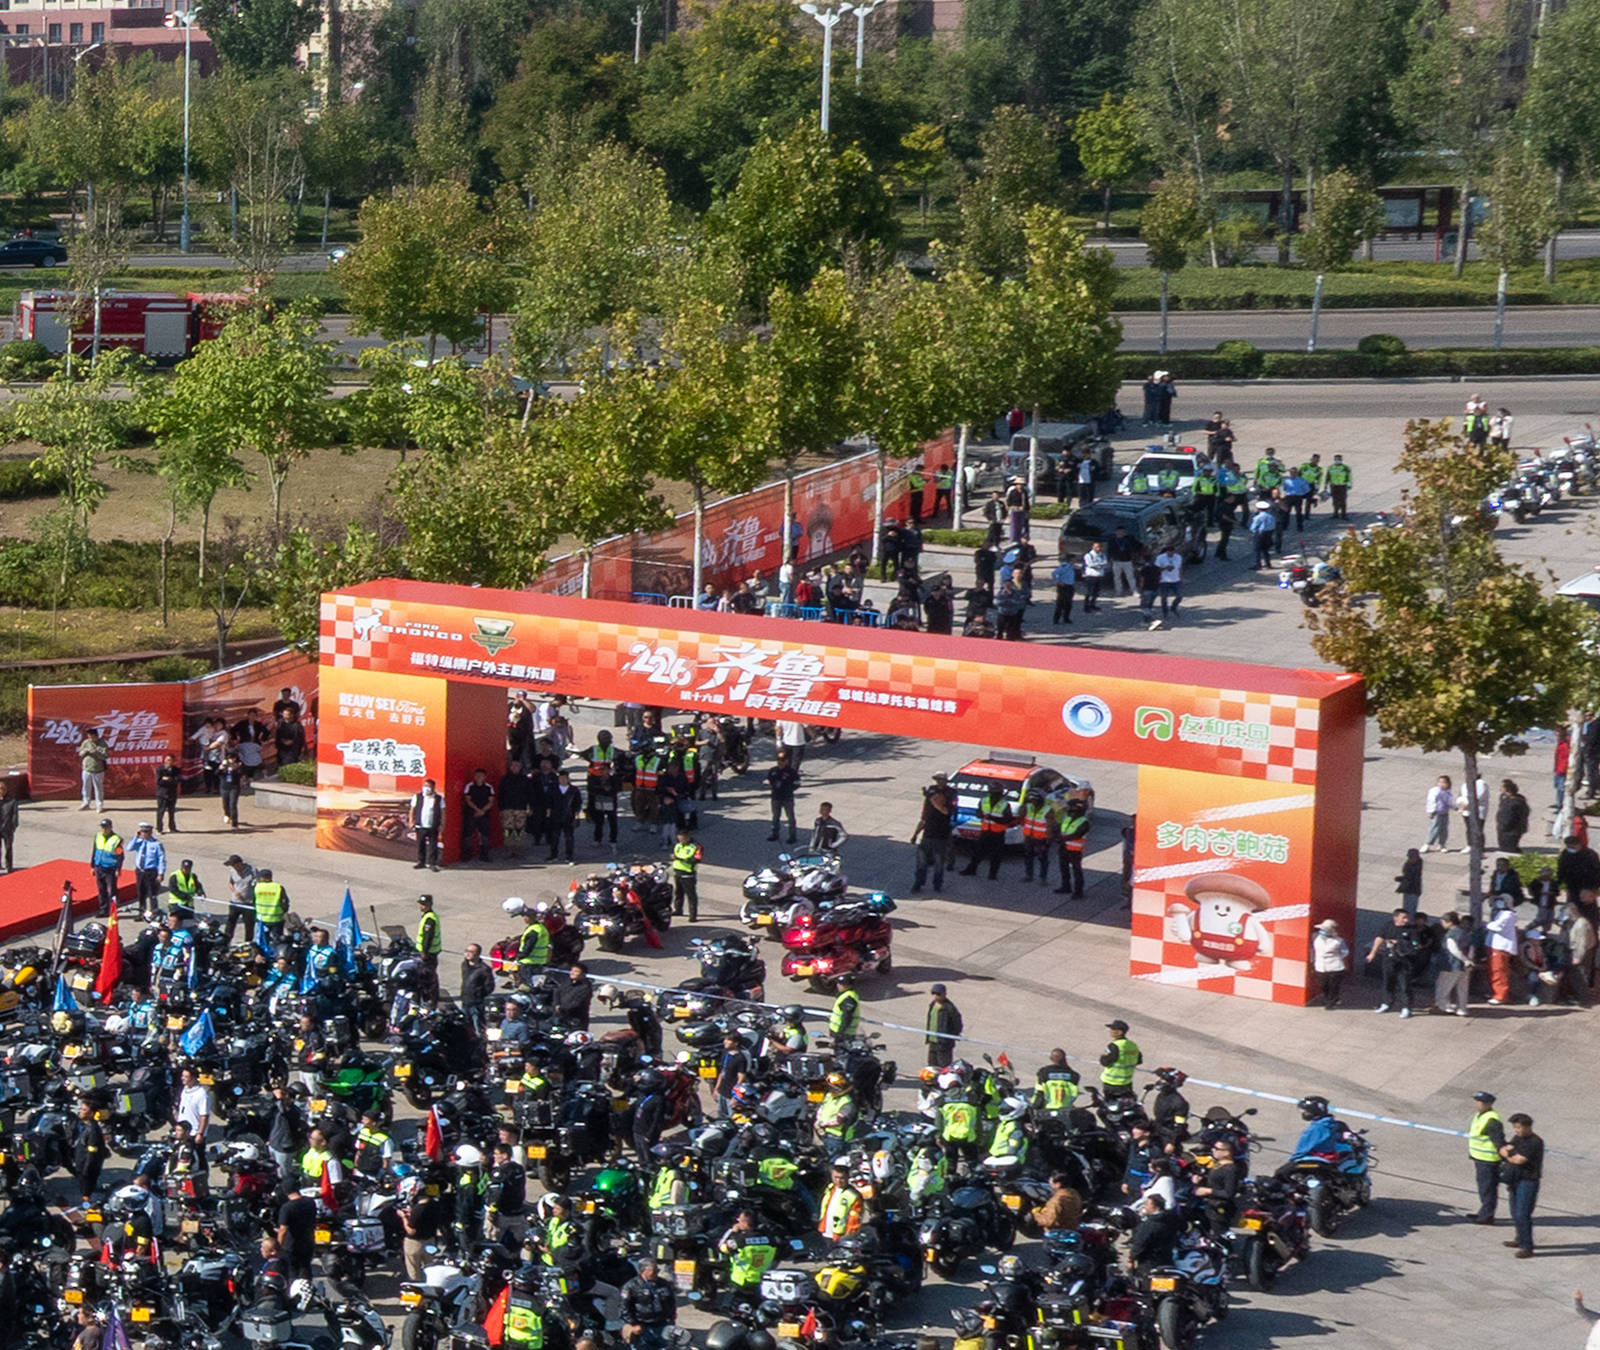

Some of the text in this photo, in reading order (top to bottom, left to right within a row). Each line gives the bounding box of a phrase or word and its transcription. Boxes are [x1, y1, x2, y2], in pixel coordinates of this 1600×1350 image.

[381, 625, 463, 641] BRONCO
[696, 640, 848, 701] 齐鲁
[338, 692, 374, 708] READY
[375, 696, 396, 712] SET
[744, 694, 842, 718] 赛车英雄会
[91, 709, 174, 749] 齐鲁
[1178, 713, 1270, 742] 友和庄园
[1156, 821, 1289, 865] 多肉杏鲍菇
